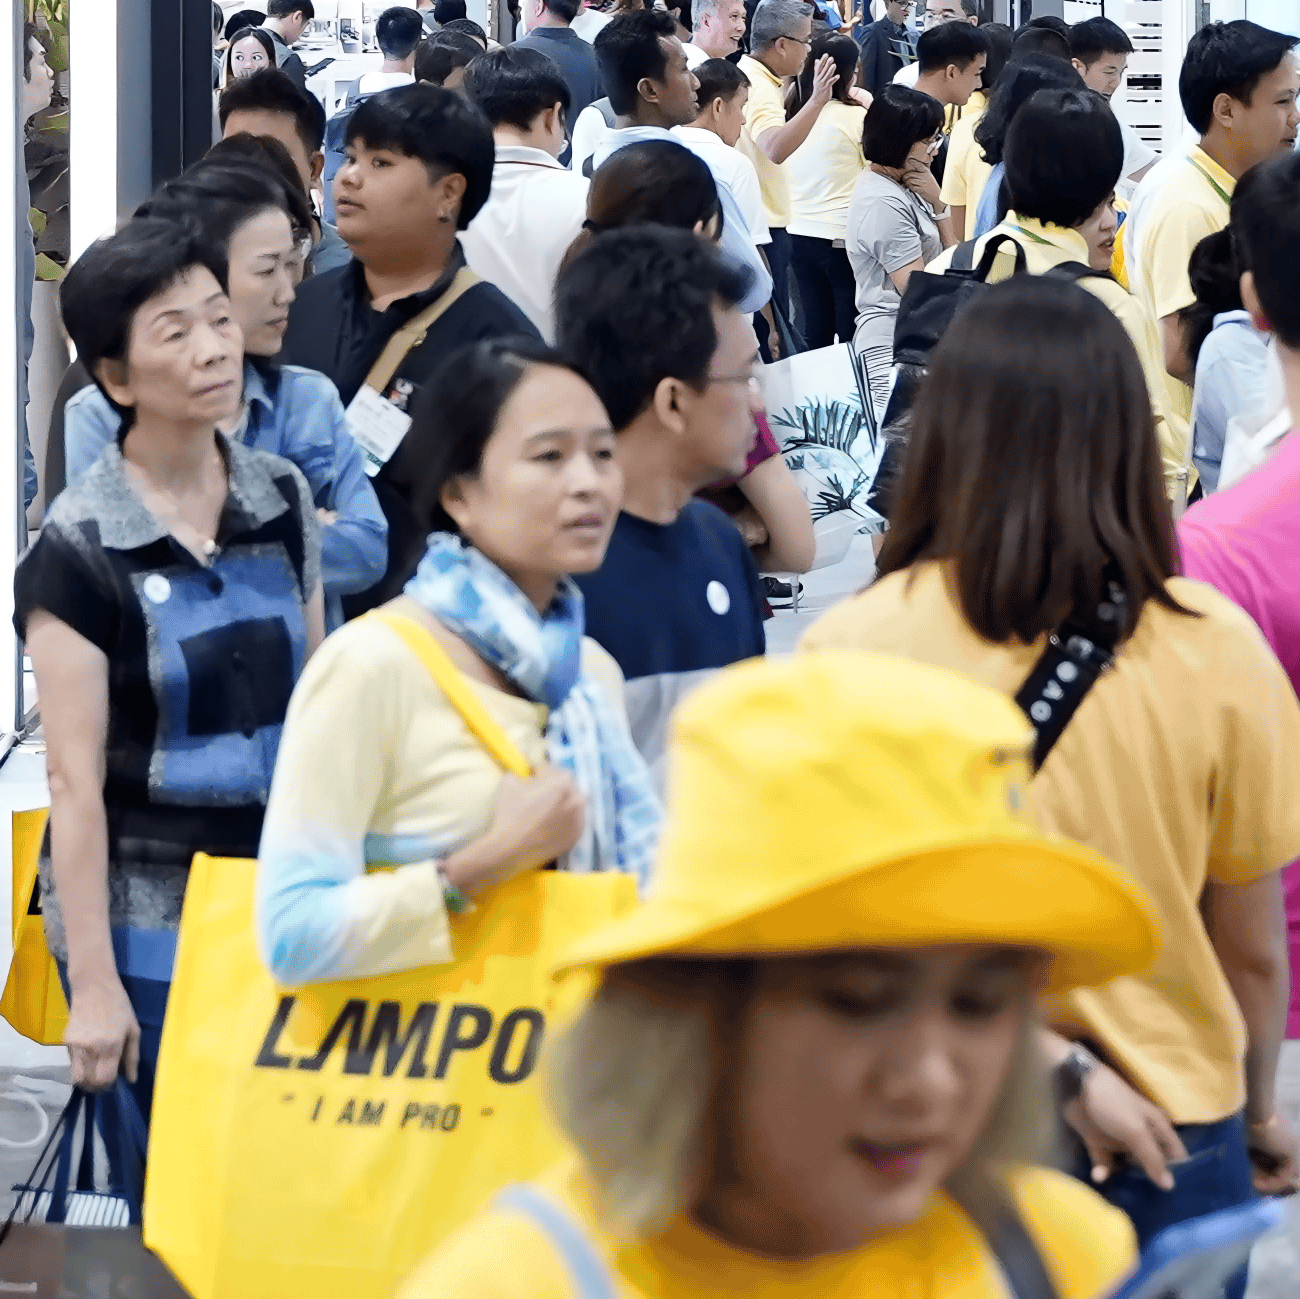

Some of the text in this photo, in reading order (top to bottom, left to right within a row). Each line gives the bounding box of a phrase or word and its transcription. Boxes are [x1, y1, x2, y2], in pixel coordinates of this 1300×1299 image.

[254, 995, 547, 1085] LAMPO
[309, 1095, 463, 1132] I AM PRO
